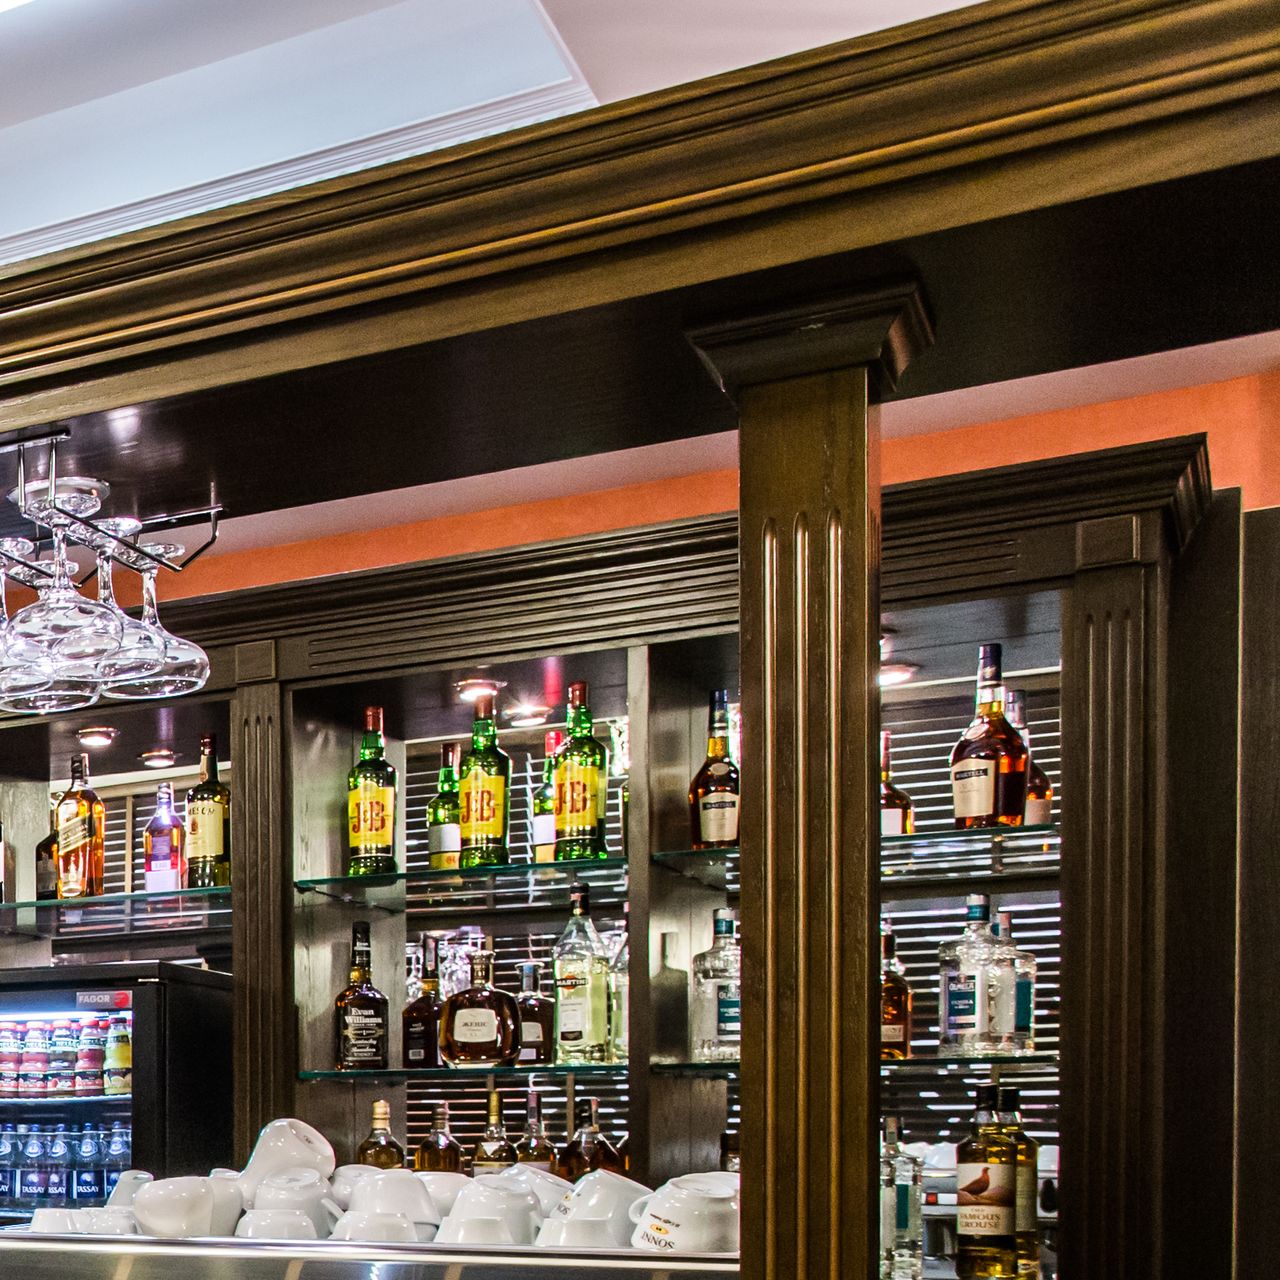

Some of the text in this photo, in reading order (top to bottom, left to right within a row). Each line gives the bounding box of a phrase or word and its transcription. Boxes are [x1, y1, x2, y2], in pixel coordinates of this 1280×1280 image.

[461, 790, 496, 824] J&B
[555, 781, 588, 815] J&B
[352, 801, 386, 833] J&B
[78, 995, 111, 1003] FAGOR
[22, 1186, 45, 1194] TASSAY
[77, 1185, 99, 1193] TASSAY
